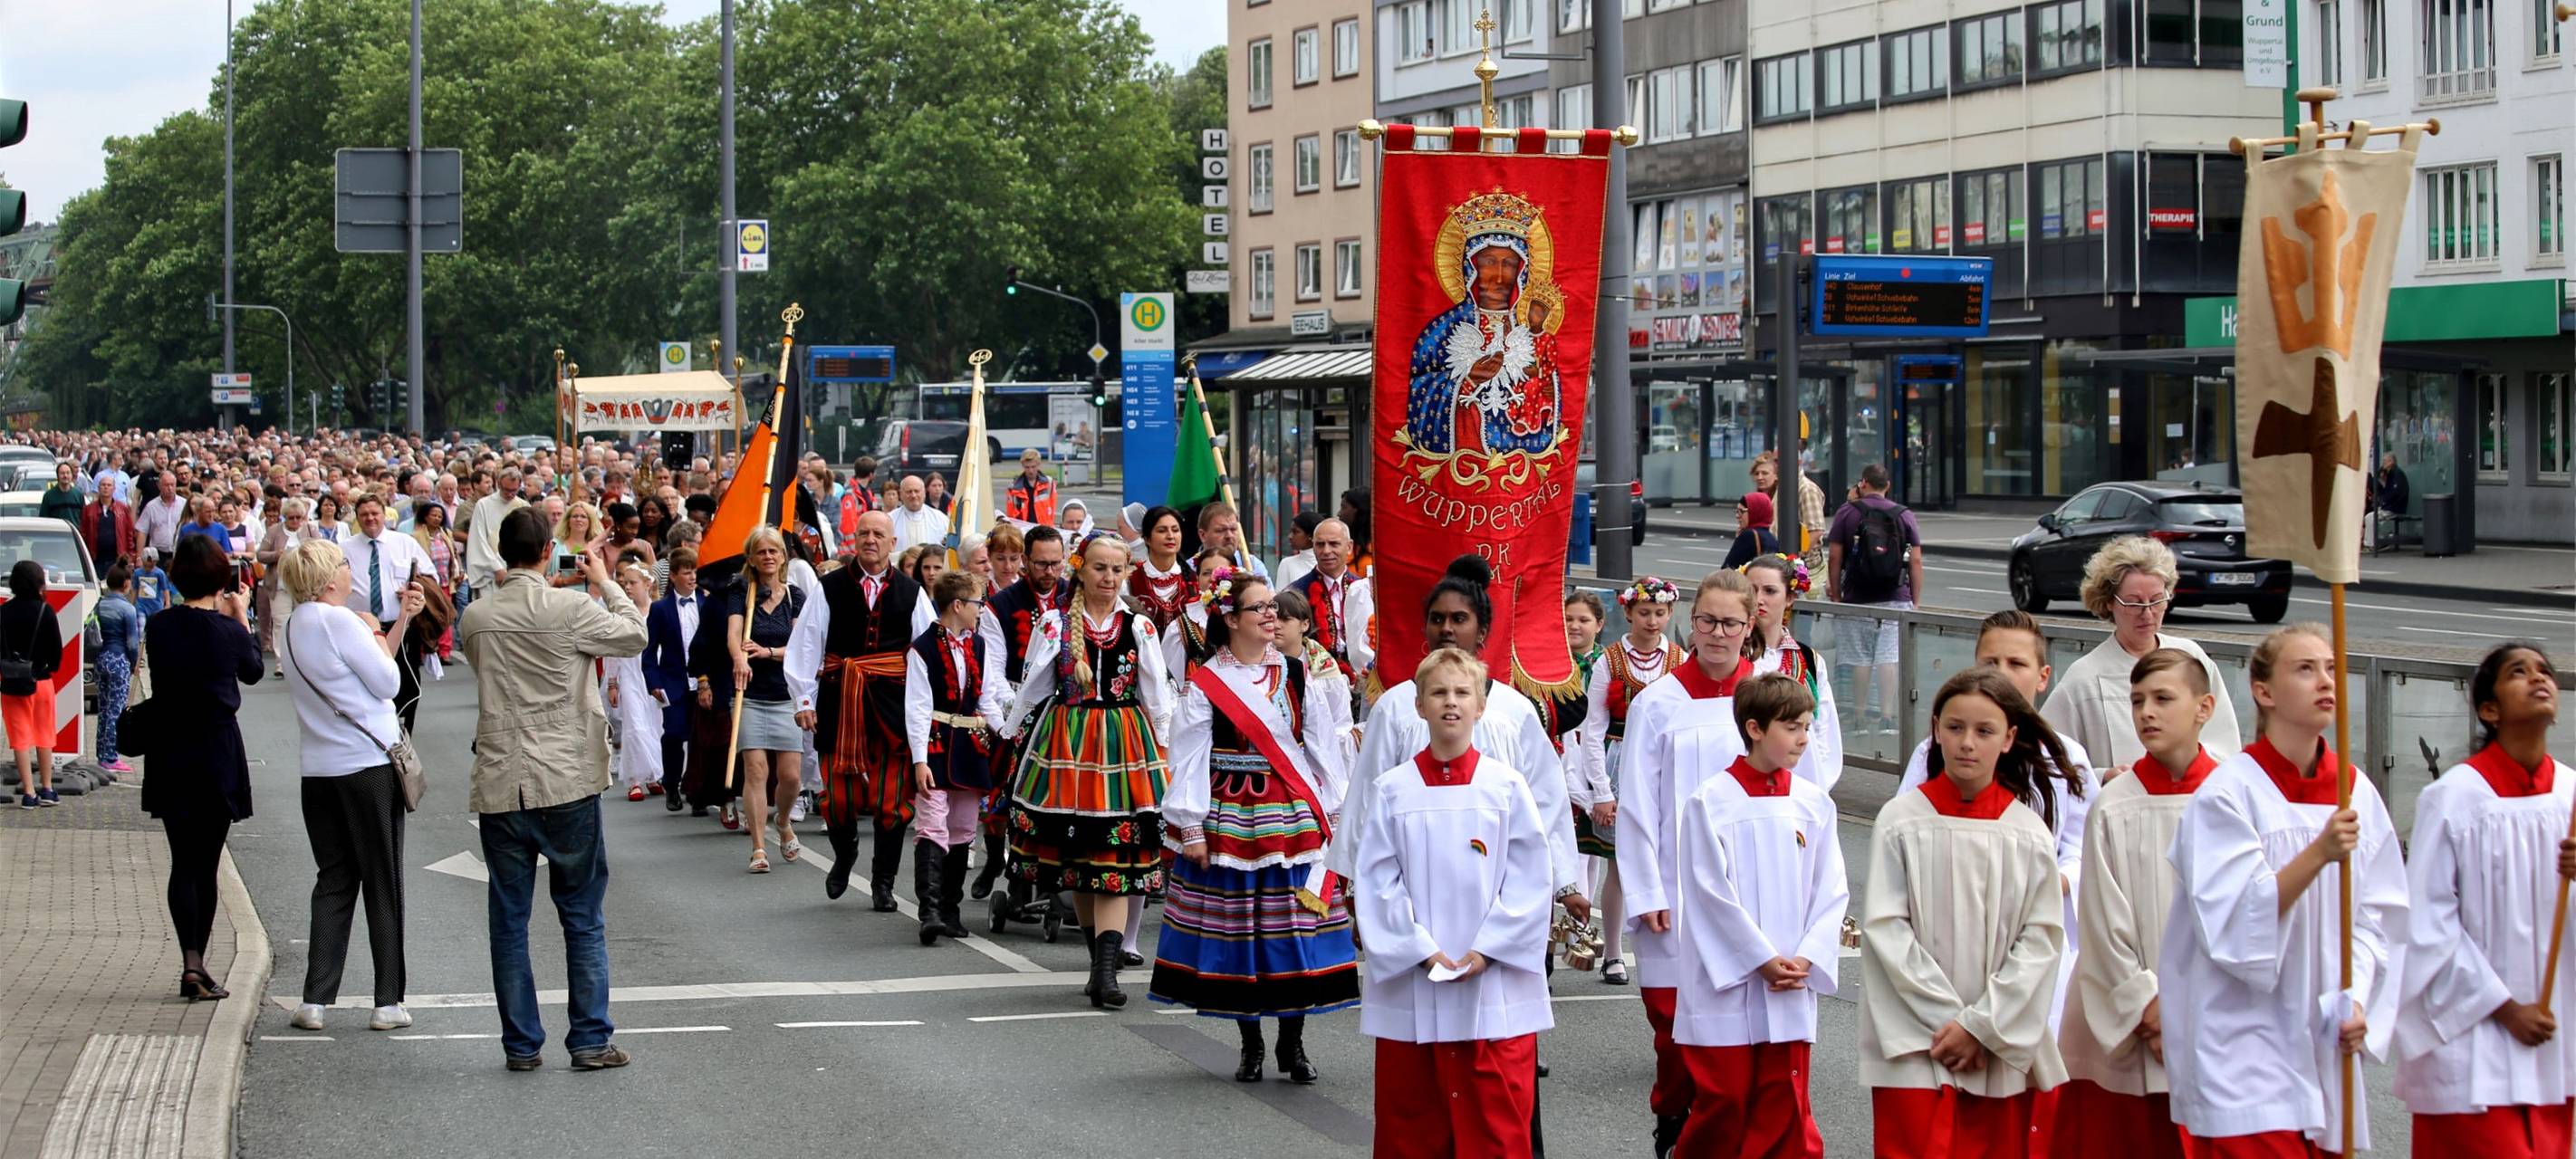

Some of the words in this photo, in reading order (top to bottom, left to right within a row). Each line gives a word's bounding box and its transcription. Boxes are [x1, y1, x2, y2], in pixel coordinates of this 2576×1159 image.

[2246, 15, 2283, 27] Grund
[2247, 37, 2283, 45] Wuppertal
[1209, 133, 1224, 261] HOTEL
[2149, 213, 2195, 223] THERAPIE
[1824, 273, 1841, 281] Linie
[1843, 273, 1856, 281] Ziel
[1959, 274, 1985, 283] Abfahrt
[2221, 305, 2238, 338] Ha
[1398, 474, 1562, 532] WUPPERTAL
